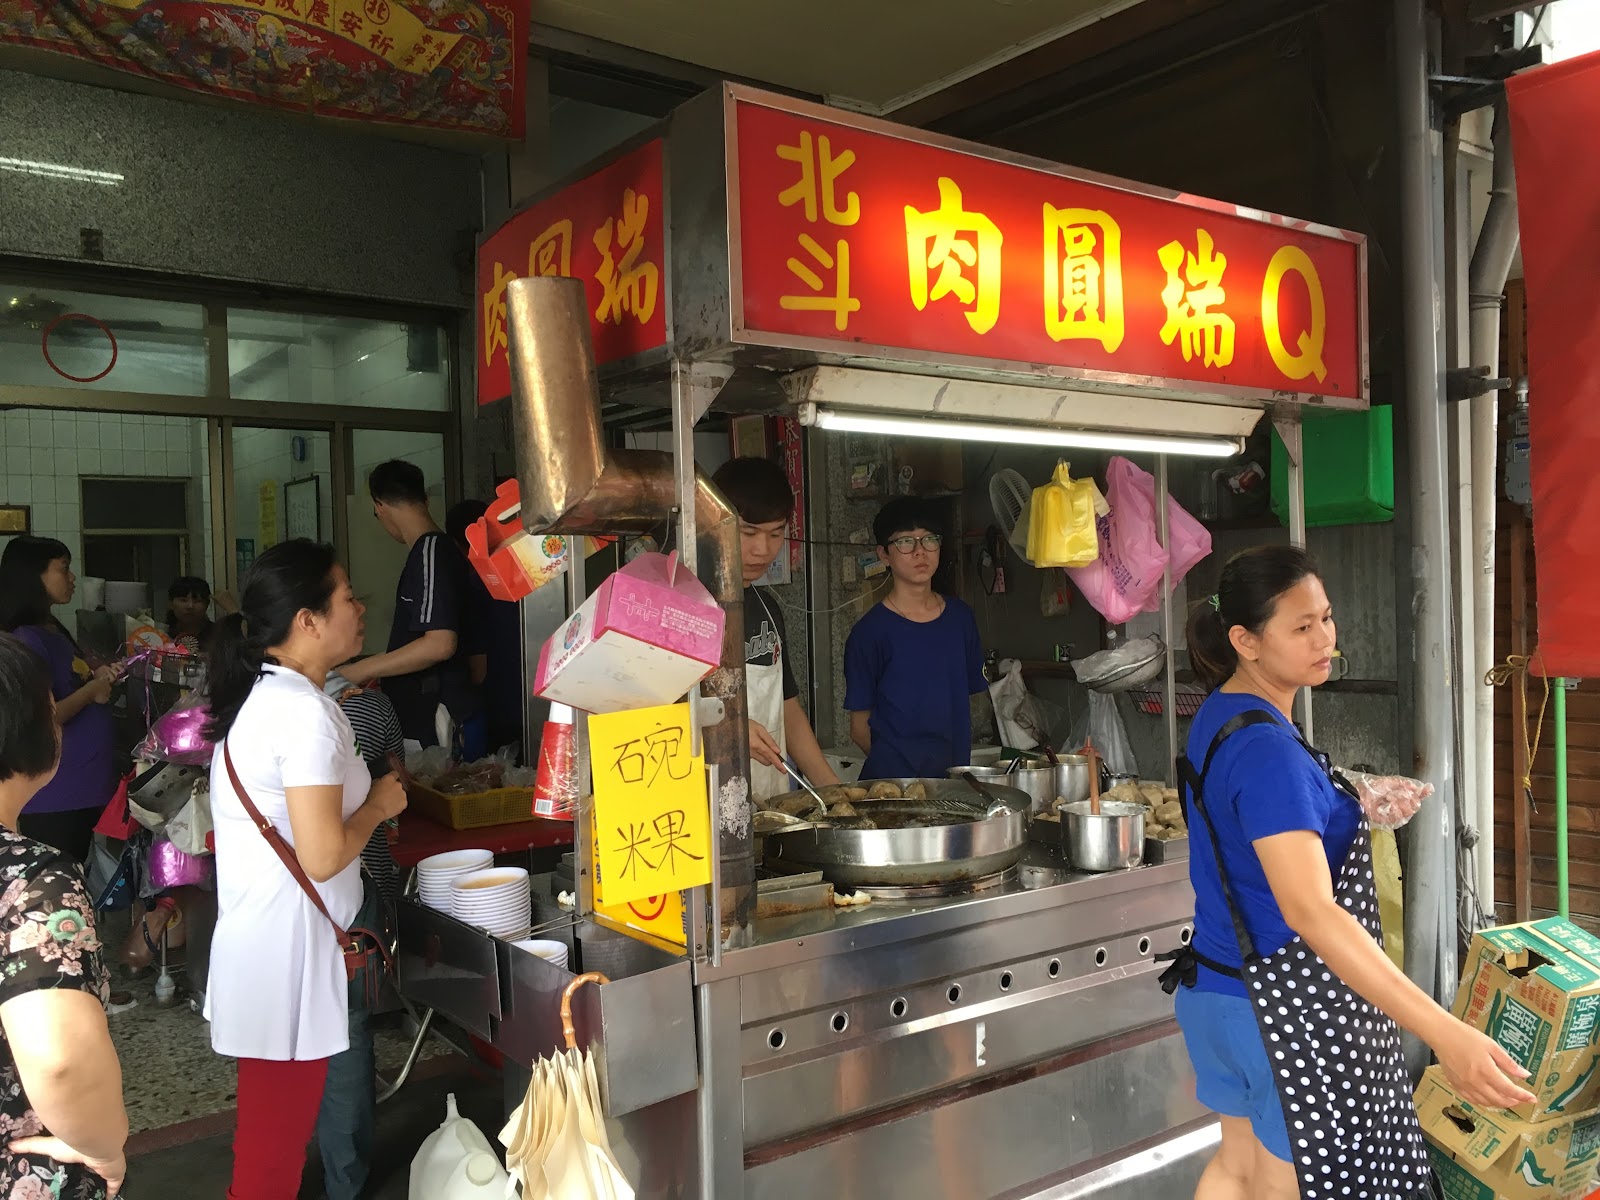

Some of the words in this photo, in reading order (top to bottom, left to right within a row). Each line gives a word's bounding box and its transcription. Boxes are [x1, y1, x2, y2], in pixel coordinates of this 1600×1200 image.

[777, 130, 861, 332] 北斗
[903, 176, 1328, 384] 肉圓瑞Q
[610, 722, 704, 882] 碗粿
